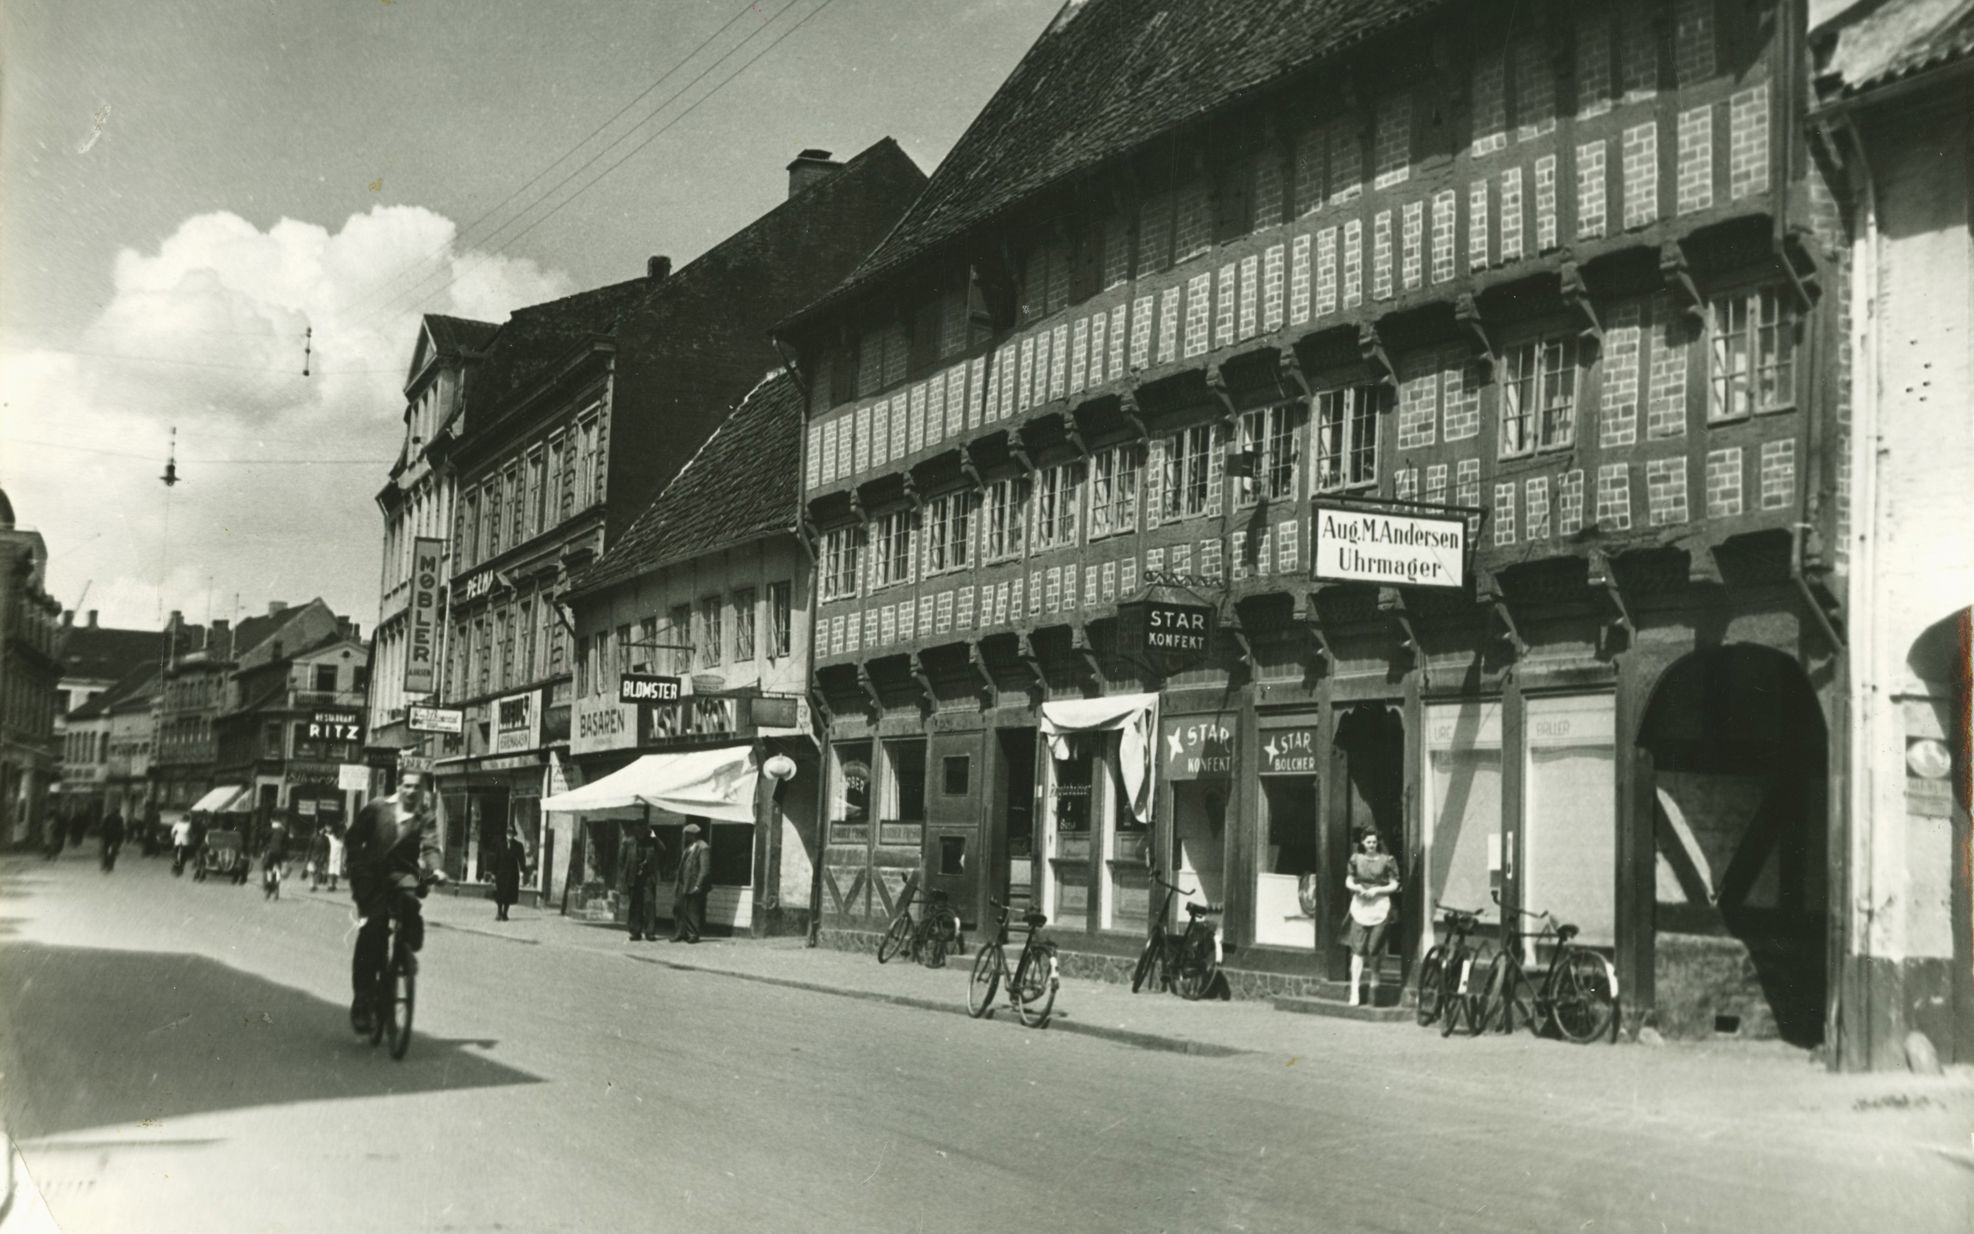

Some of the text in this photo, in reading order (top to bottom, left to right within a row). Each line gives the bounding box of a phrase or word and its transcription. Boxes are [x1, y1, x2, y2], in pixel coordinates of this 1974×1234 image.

[1338, 546, 1442, 582] Uhrmager
[413, 555, 436, 663] MØBLER
[1150, 611, 1205, 629] STAR
[1148, 632, 1204, 649] KONFEKT
[622, 680, 677, 699] BLOMSTER
[309, 723, 360, 740] RITZ
[580, 709, 625, 738] BASAREN
[1187, 723, 1230, 753] STAR
[1281, 732, 1312, 753] STAR
[1187, 756, 1231, 773] KONFEKT
[1275, 757, 1315, 771] BOLCHER
